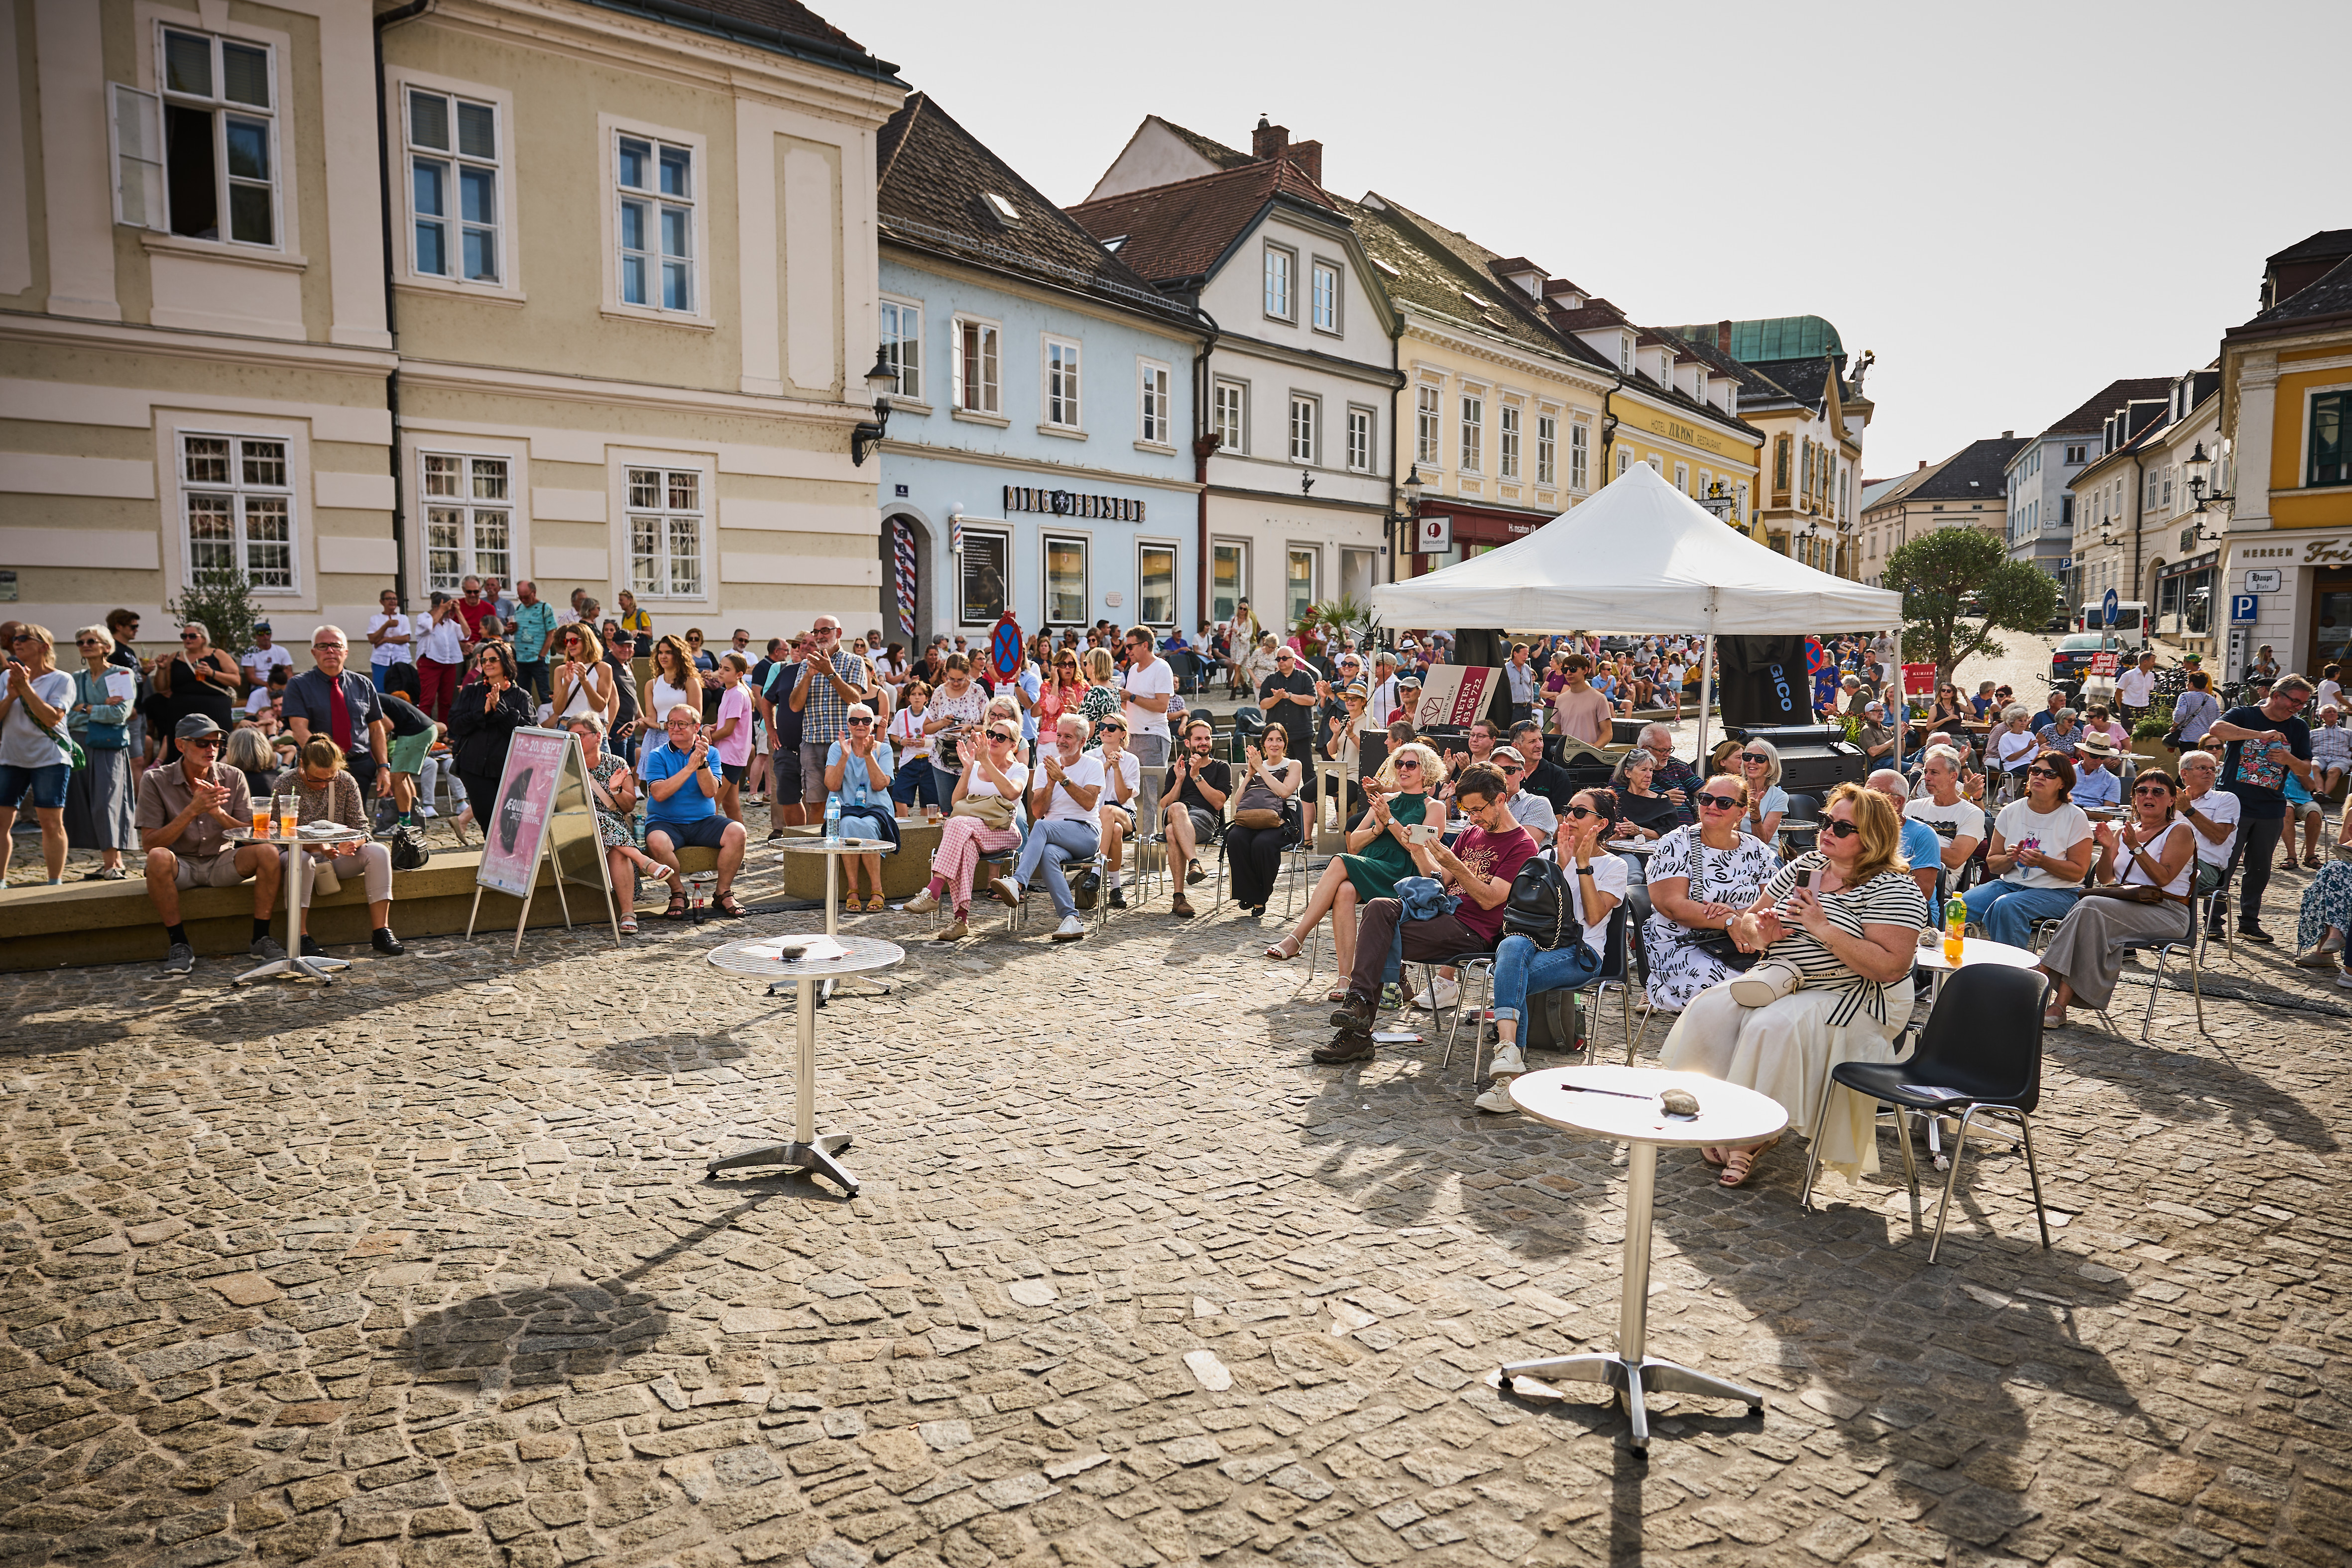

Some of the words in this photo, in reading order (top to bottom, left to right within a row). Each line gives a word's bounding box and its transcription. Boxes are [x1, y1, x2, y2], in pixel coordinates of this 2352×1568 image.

[1651, 419, 1665, 433] HOTEL
[1669, 422, 1680, 439] ZUR
[1681, 426, 1694, 443] POST
[1697, 434, 1721, 450] RESTAURANT
[1007, 485, 1050, 512] KING
[1074, 493, 1146, 522] FRISEUR
[2243, 548, 2293, 558] HERREN
[2062, 559, 2069, 567] P
[2237, 597, 2253, 618] P
[1470, 678, 1482, 695] 722
[1467, 698, 1475, 709] 68
[1462, 711, 1471, 723] 83
[529, 740, 540, 752] 20.
[541, 742, 562, 755] SEPT.
[510, 812, 522, 821] JAZZ
[522, 814, 540, 825] FESTIVAL
